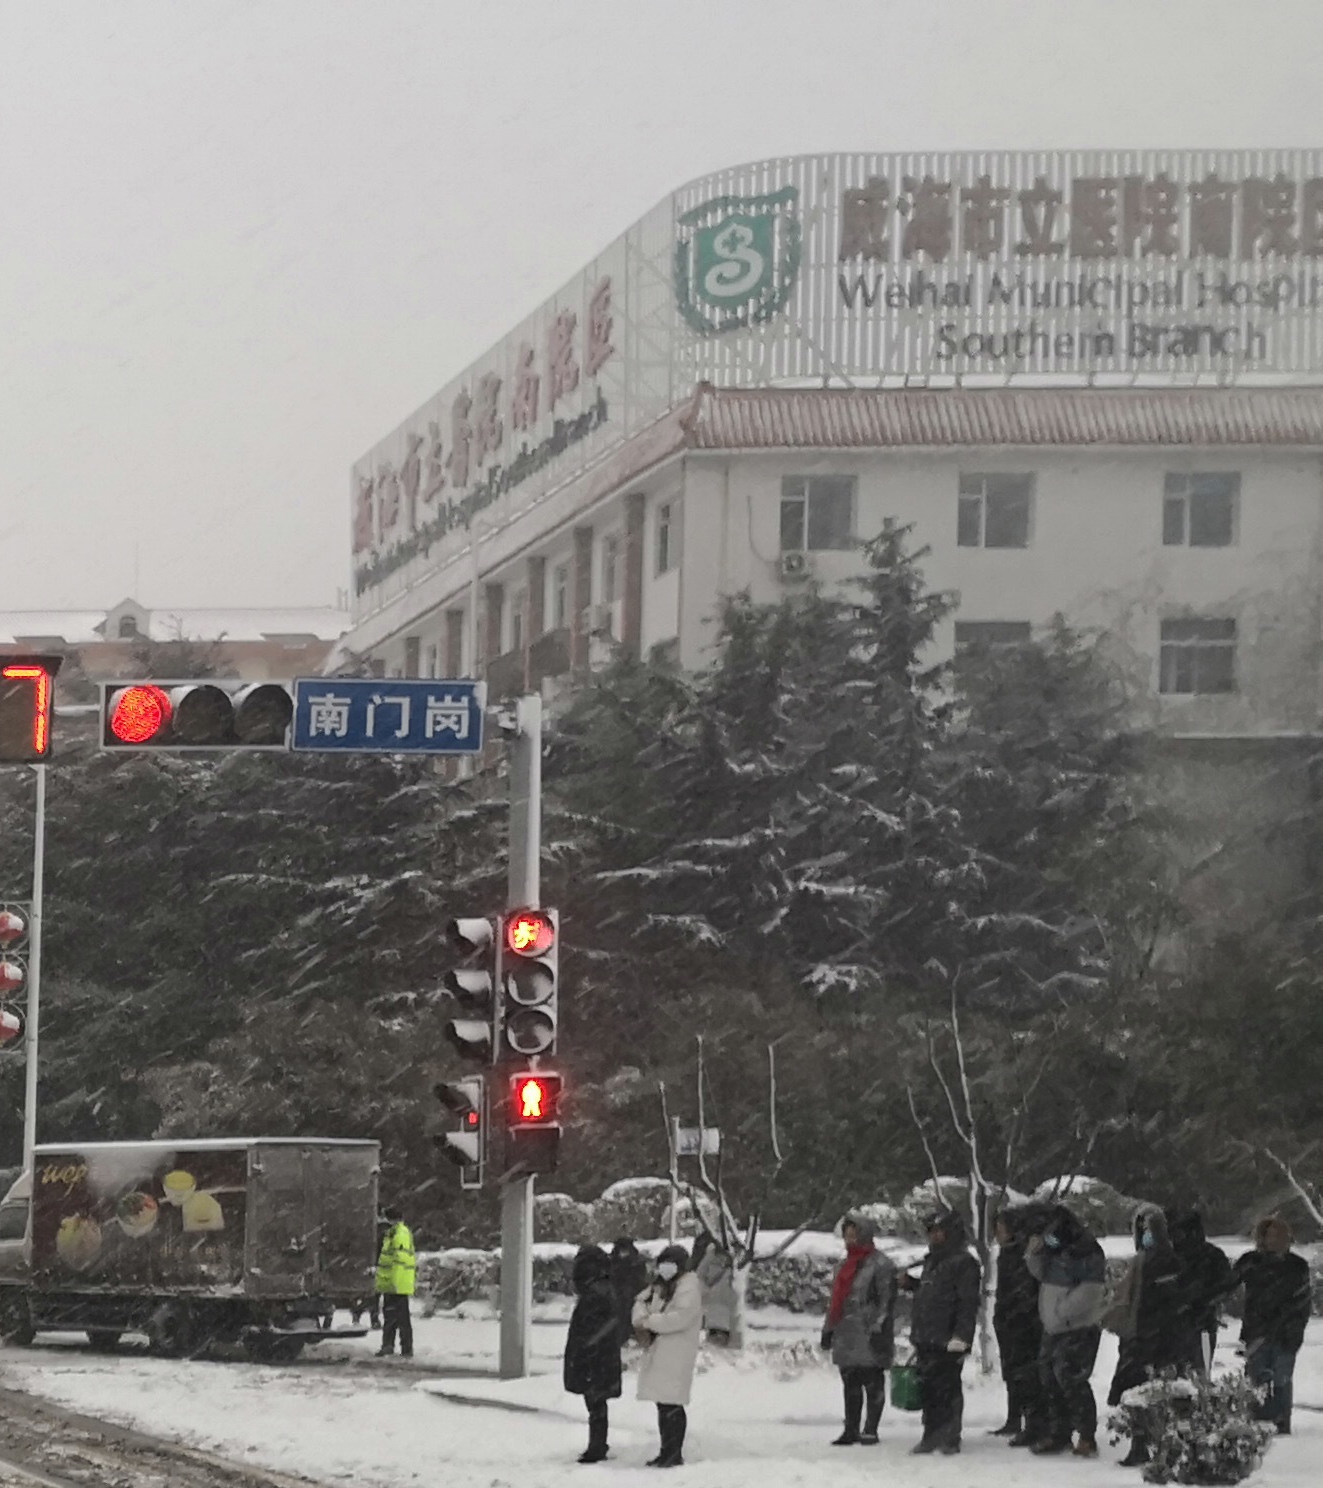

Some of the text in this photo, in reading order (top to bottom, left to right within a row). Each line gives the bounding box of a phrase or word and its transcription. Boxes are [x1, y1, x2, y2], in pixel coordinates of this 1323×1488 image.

[987, 272, 1183, 320] Municipal
[938, 321, 1268, 360] Southern Branch
[308, 692, 470, 740] 南门岗
